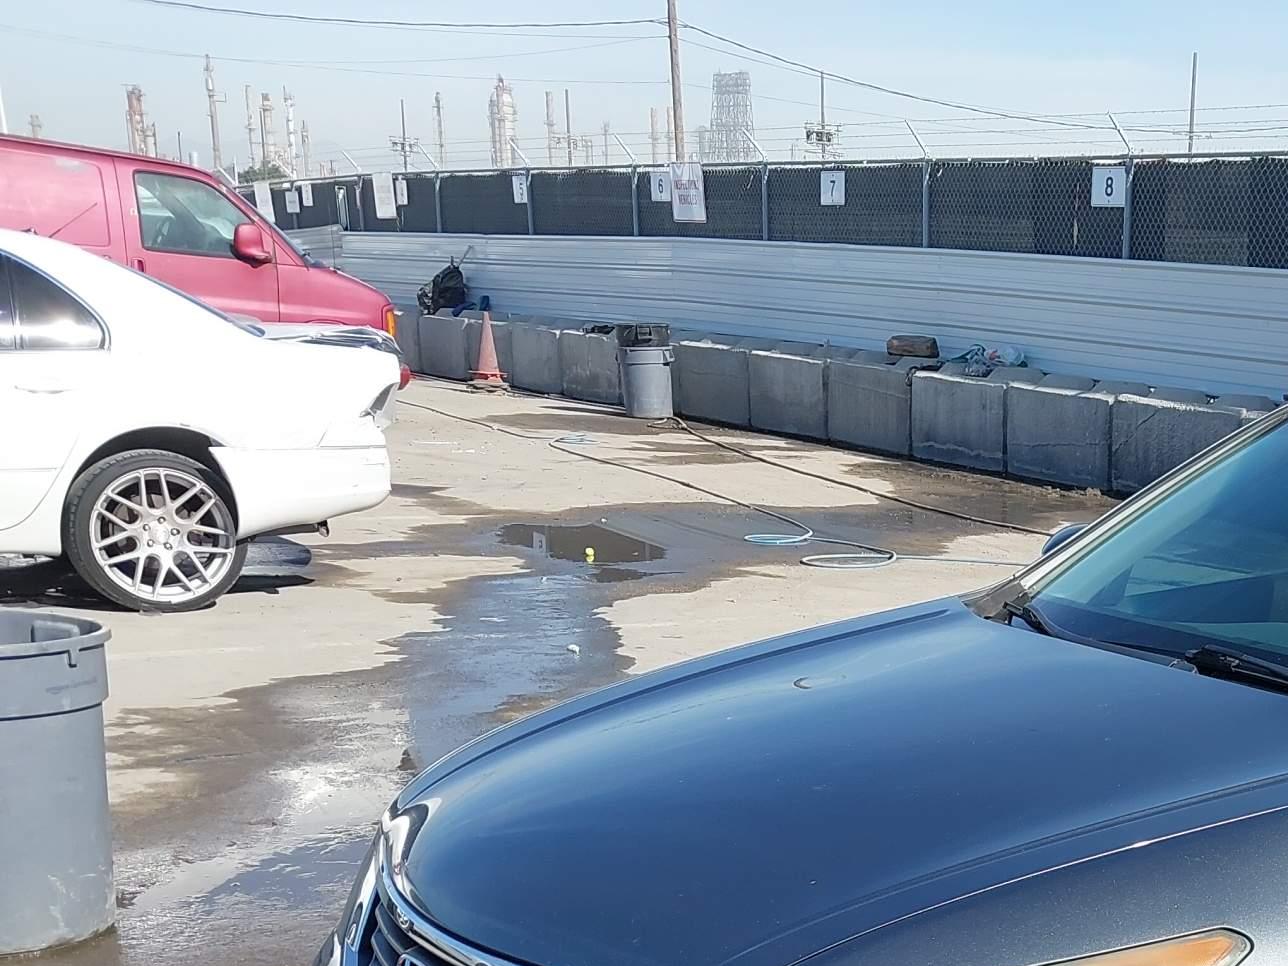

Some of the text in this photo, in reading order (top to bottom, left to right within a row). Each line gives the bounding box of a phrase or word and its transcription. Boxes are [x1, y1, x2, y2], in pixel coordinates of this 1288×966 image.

[657, 178, 664, 194] 6
[829, 180, 836, 197] 7
[1105, 176, 1113, 197] 8
